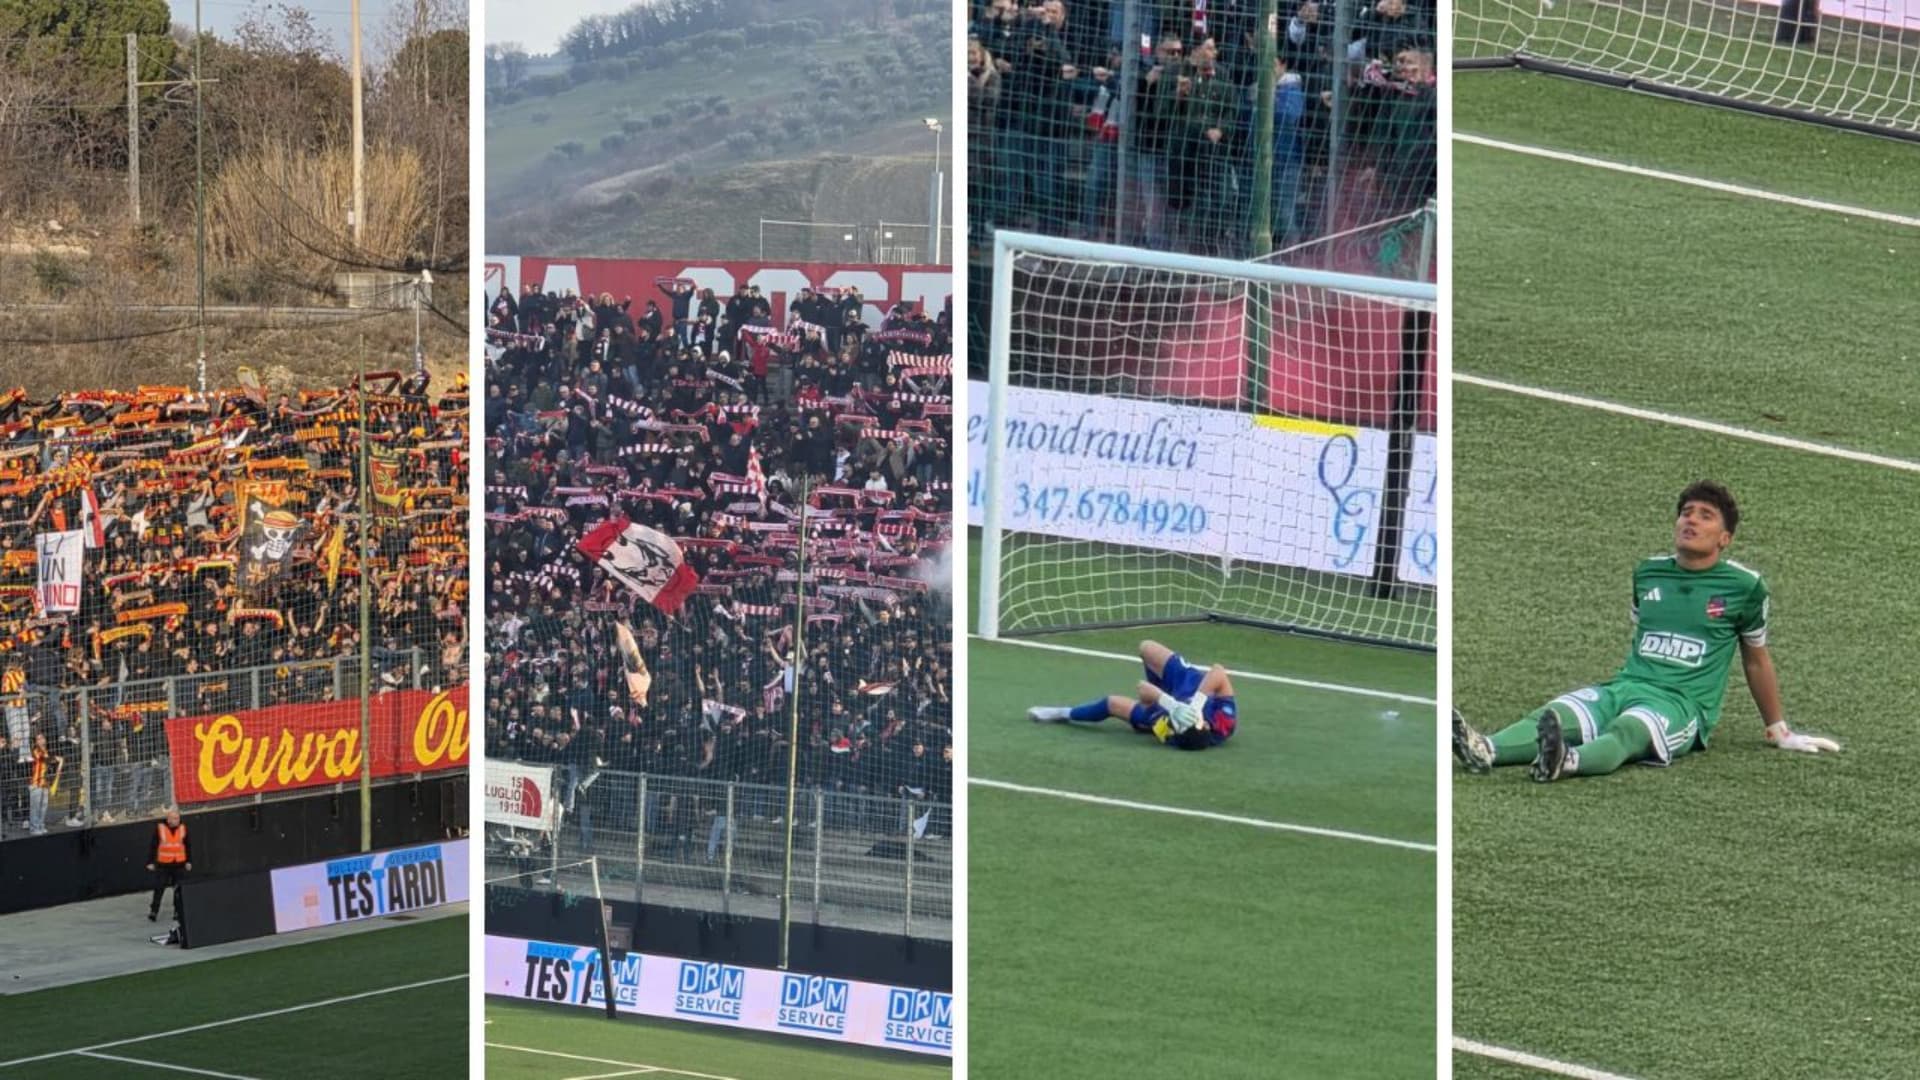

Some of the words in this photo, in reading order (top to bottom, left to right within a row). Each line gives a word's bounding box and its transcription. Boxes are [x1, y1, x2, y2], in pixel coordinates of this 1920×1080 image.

[1012, 482, 1207, 535] 347.6784920
[1640, 634, 1701, 659] DMP
[194, 714, 362, 794] Curva
[484, 784, 521, 801] LUGLIO
[499, 801, 520, 814] 1913
[327, 860, 446, 920] TESTARDI
[680, 963, 743, 999] DRM
[783, 976, 847, 1012] DRM
[676, 994, 742, 1015] SERVICE
[778, 1008, 844, 1029] SERVICE
[890, 991, 952, 1026] DRM
[885, 1022, 952, 1044] SERVICE
